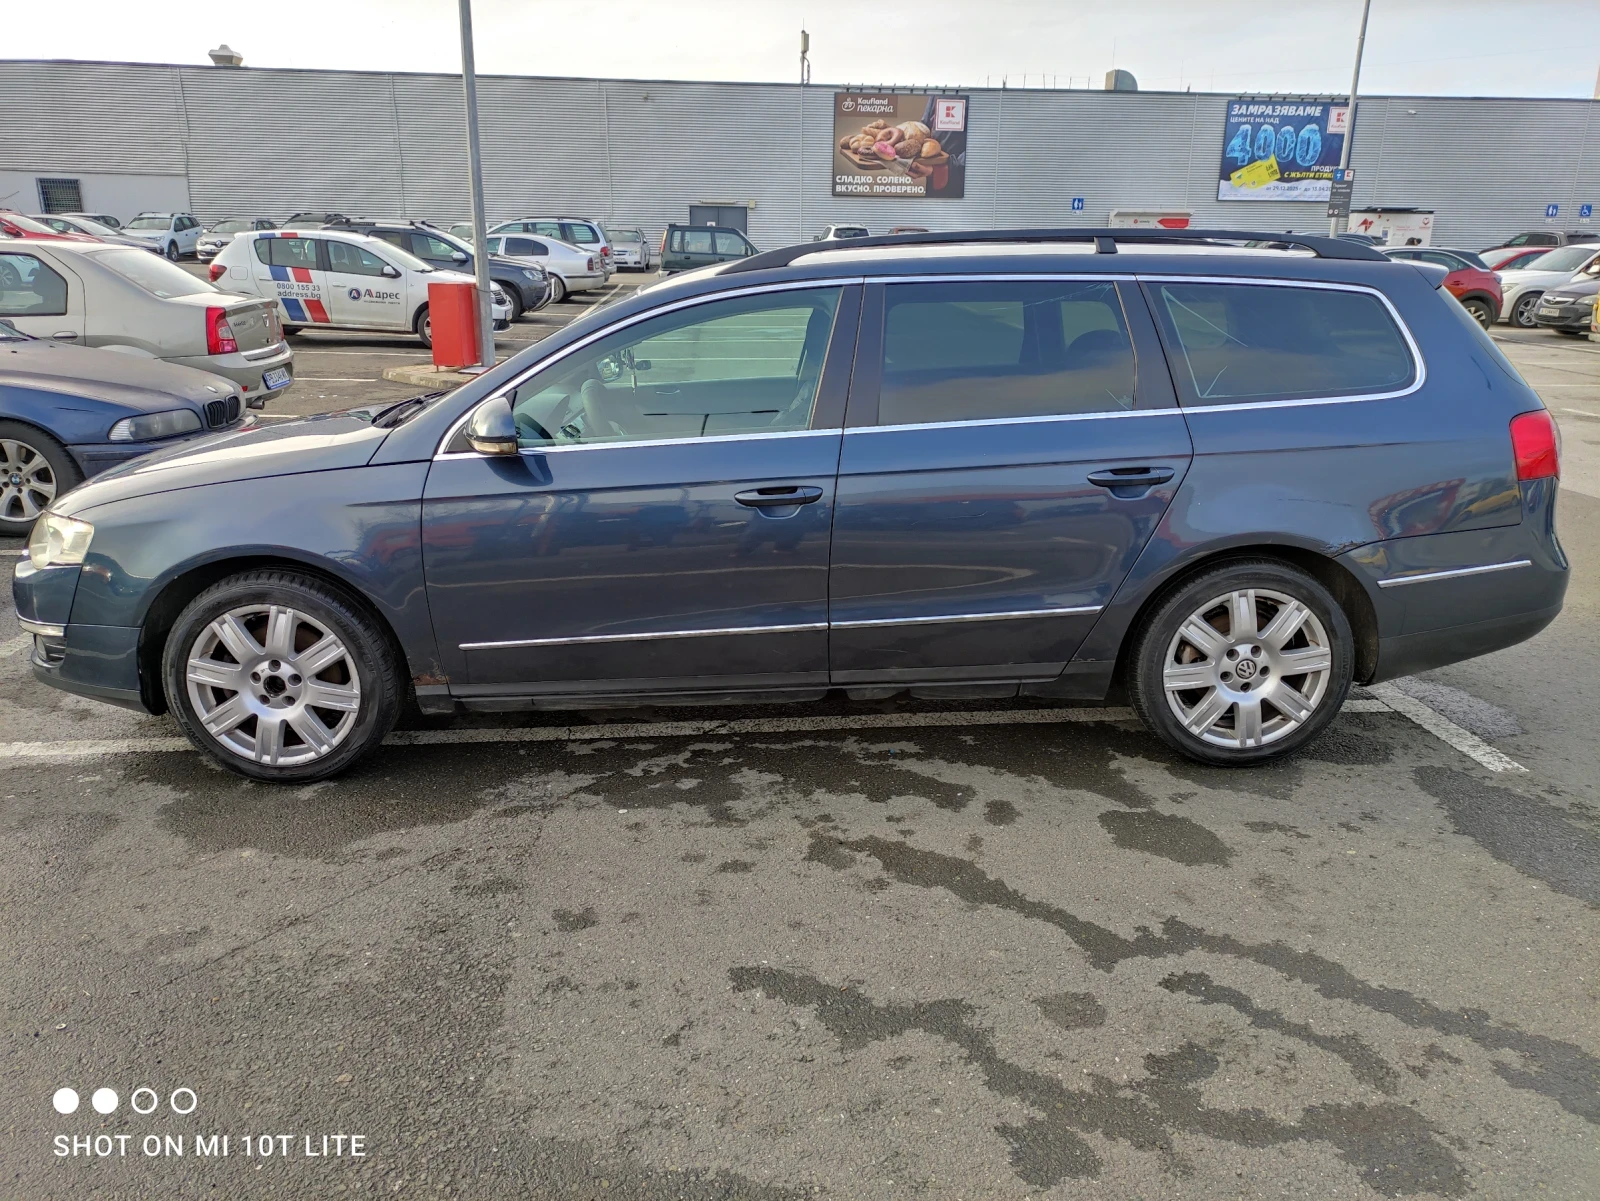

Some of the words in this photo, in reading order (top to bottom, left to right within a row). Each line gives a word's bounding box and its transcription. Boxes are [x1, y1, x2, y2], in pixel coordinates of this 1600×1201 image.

[857, 97, 888, 105] Kaufland
[857, 105, 894, 114] пекарна
[1231, 104, 1323, 116] ЗАМРАЗЯВАМЕ
[1230, 116, 1255, 124] ЦЕНИТЕ
[1226, 123, 1322, 166] 4000
[836, 175, 875, 184] СЛАДКО.
[876, 176, 914, 184] СОЛЕНО.
[836, 184, 872, 193] ВКУСНО.
[873, 185, 926, 194] ПРОВЕРЕНО.
[276, 282, 295, 290] 0800
[277, 290, 322, 299] address.bg
[363, 288, 400, 300] Адрес
